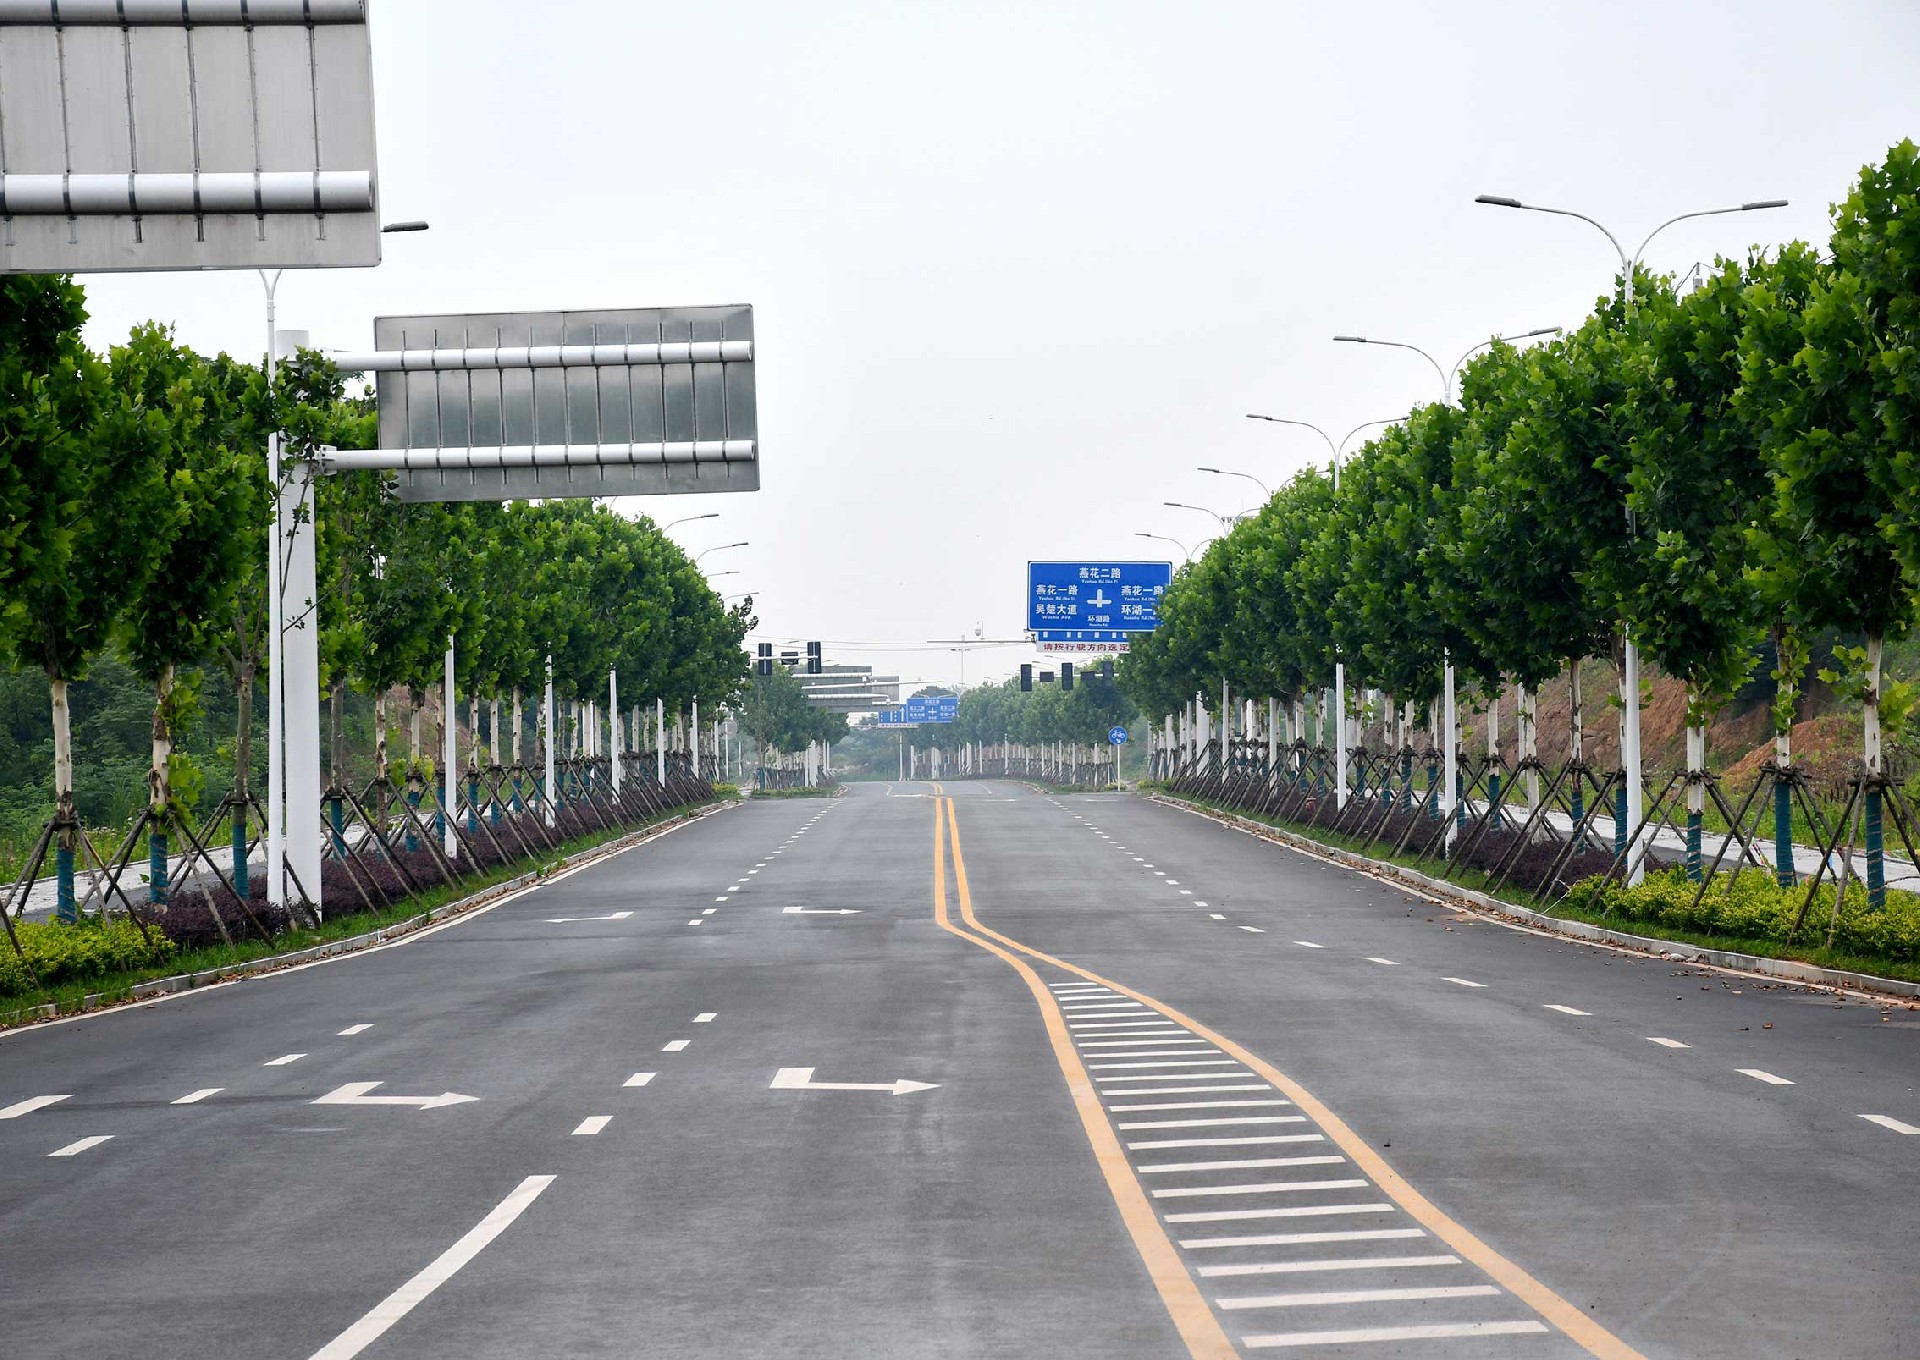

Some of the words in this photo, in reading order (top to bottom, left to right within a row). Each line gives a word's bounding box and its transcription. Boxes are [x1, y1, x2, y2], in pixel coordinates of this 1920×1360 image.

[1079, 567, 1121, 579] 燕花二路
[1036, 584, 1078, 595] 燕花一路
[1121, 585, 1164, 596] 燕花一路
[1036, 604, 1077, 615] 吴楚大道
[1121, 604, 1157, 616] 环湖一
